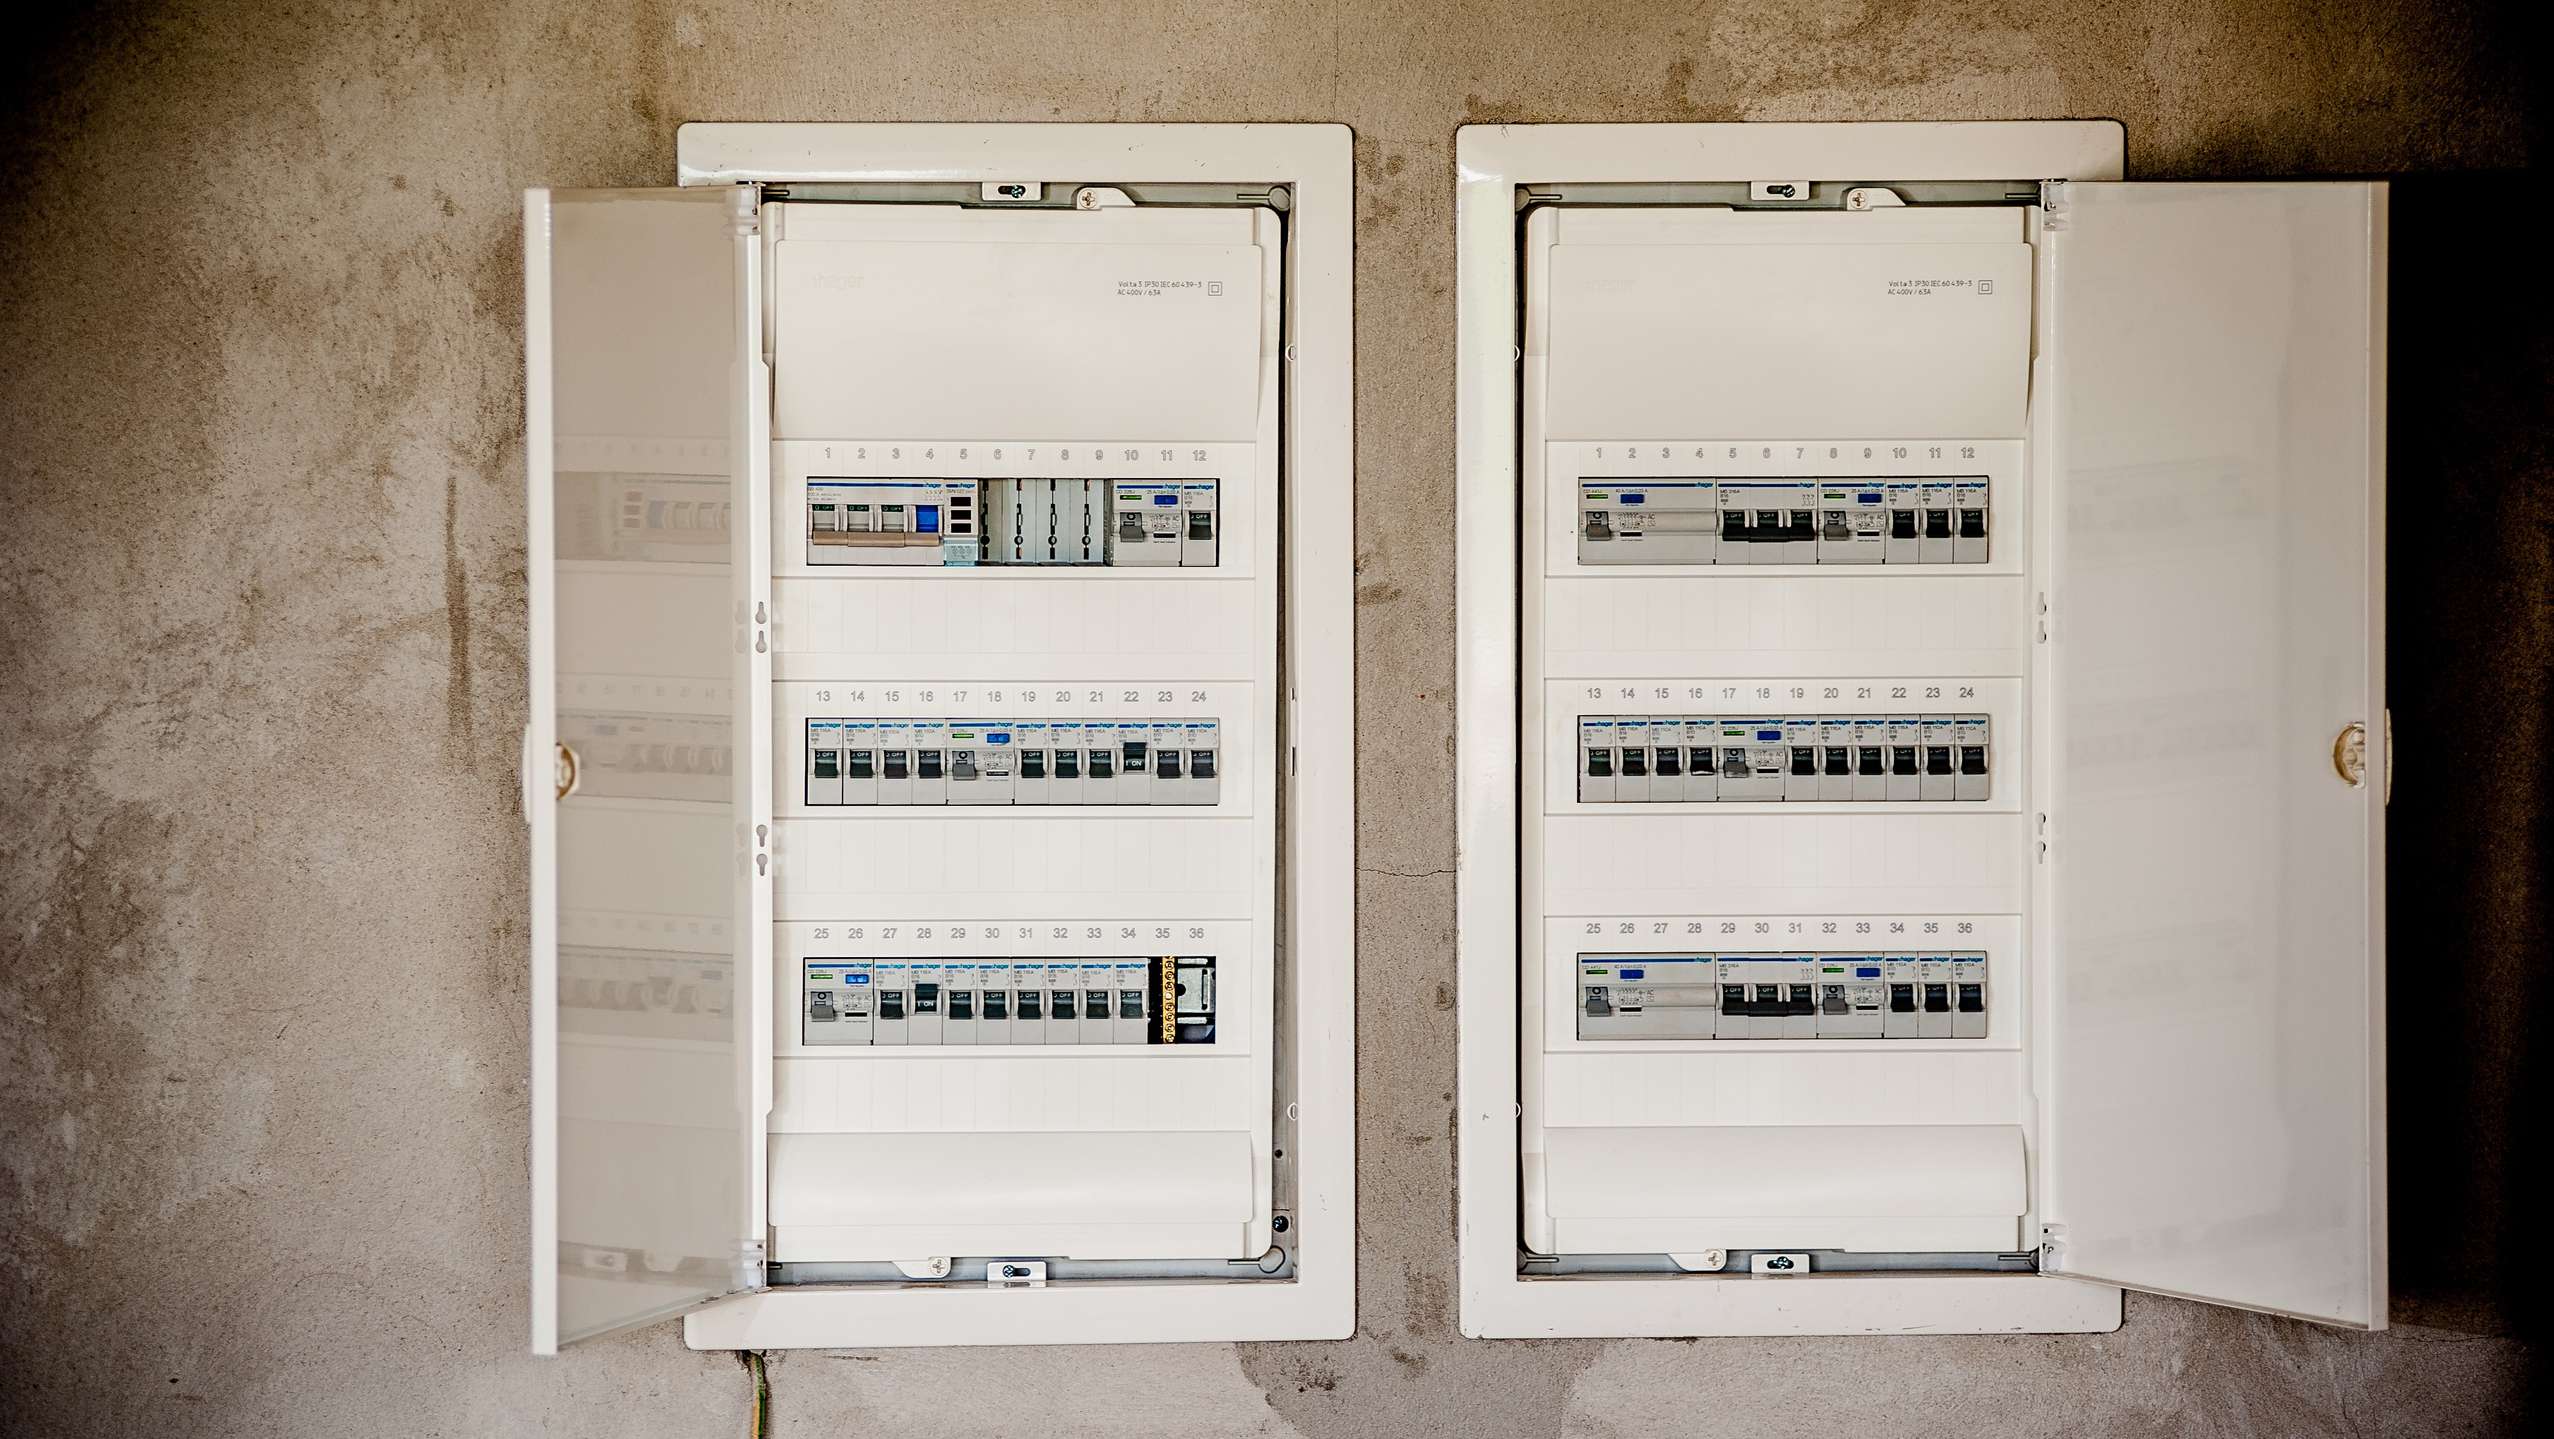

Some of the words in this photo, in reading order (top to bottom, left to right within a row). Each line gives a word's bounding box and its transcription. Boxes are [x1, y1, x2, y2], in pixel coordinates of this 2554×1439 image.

[825, 447, 830, 459] 1
[858, 448, 865, 459] 2
[892, 448, 900, 459] 3
[926, 448, 934, 460] 4
[960, 448, 967, 459] 5
[994, 449, 1001, 460] 6
[1028, 449, 1035, 460] 7
[1061, 449, 1069, 461] 8
[1095, 449, 1103, 461] 9
[1125, 449, 1139, 461] 10
[1161, 448, 1172, 461] 11
[1193, 450, 1207, 461] 12
[1596, 447, 1602, 459] 1
[1629, 448, 1636, 459] 2
[1662, 447, 1670, 458] 3
[1696, 448, 1703, 458] 4
[1729, 448, 1737, 458] 5
[1763, 448, 1771, 459] 6
[1797, 448, 1804, 459] 7
[1830, 448, 1837, 459] 8
[1864, 448, 1872, 459] 9
[1893, 447, 1907, 459] 10
[1929, 447, 1941, 459] 11
[1961, 447, 1975, 459] 12
[817, 690, 830, 702] 13
[851, 690, 864, 702] 14
[885, 691, 899, 702] 15
[920, 691, 933, 702] 16
[954, 691, 967, 702] 17
[988, 691, 1002, 702] 18
[1022, 691, 1036, 702] 19
[1056, 691, 1071, 702] 20
[1090, 690, 1103, 702] 21
[1124, 691, 1139, 702] 22
[1158, 691, 1173, 702] 23
[1192, 691, 1207, 702] 24
[1587, 688, 1601, 699] 13
[1621, 688, 1635, 699] 14
[1655, 688, 1669, 699] 15
[1689, 688, 1702, 699] 16
[1722, 688, 1736, 699] 17
[1756, 688, 1770, 699] 18
[1790, 688, 1804, 699] 19
[1824, 688, 1839, 698] 20
[1857, 688, 1871, 698] 21
[1891, 687, 1906, 698] 22
[1926, 687, 1940, 698] 23
[1959, 687, 1974, 698] 24
[814, 928, 829, 939] 25
[848, 928, 863, 939] 26
[883, 928, 897, 939] 27
[917, 928, 931, 940] 28
[951, 928, 966, 939] 29
[985, 928, 1000, 938] 30
[1020, 928, 1032, 939] 31
[1053, 928, 1068, 938] 32
[1087, 928, 1102, 938] 33
[1121, 928, 1136, 938] 34
[1156, 928, 1170, 938] 35
[1189, 928, 1204, 940] 36
[1586, 923, 1601, 934] 25
[1620, 923, 1635, 934] 26
[1654, 923, 1668, 934] 27
[1688, 923, 1702, 934] 28
[1721, 922, 1736, 933] 29
[1755, 922, 1769, 935] 30
[1789, 922, 1801, 933] 31
[1822, 922, 1837, 935] 32
[1856, 922, 1870, 933] 33
[1890, 922, 1904, 935] 34
[1924, 922, 1938, 933] 35
[1958, 922, 1972, 934] 36
